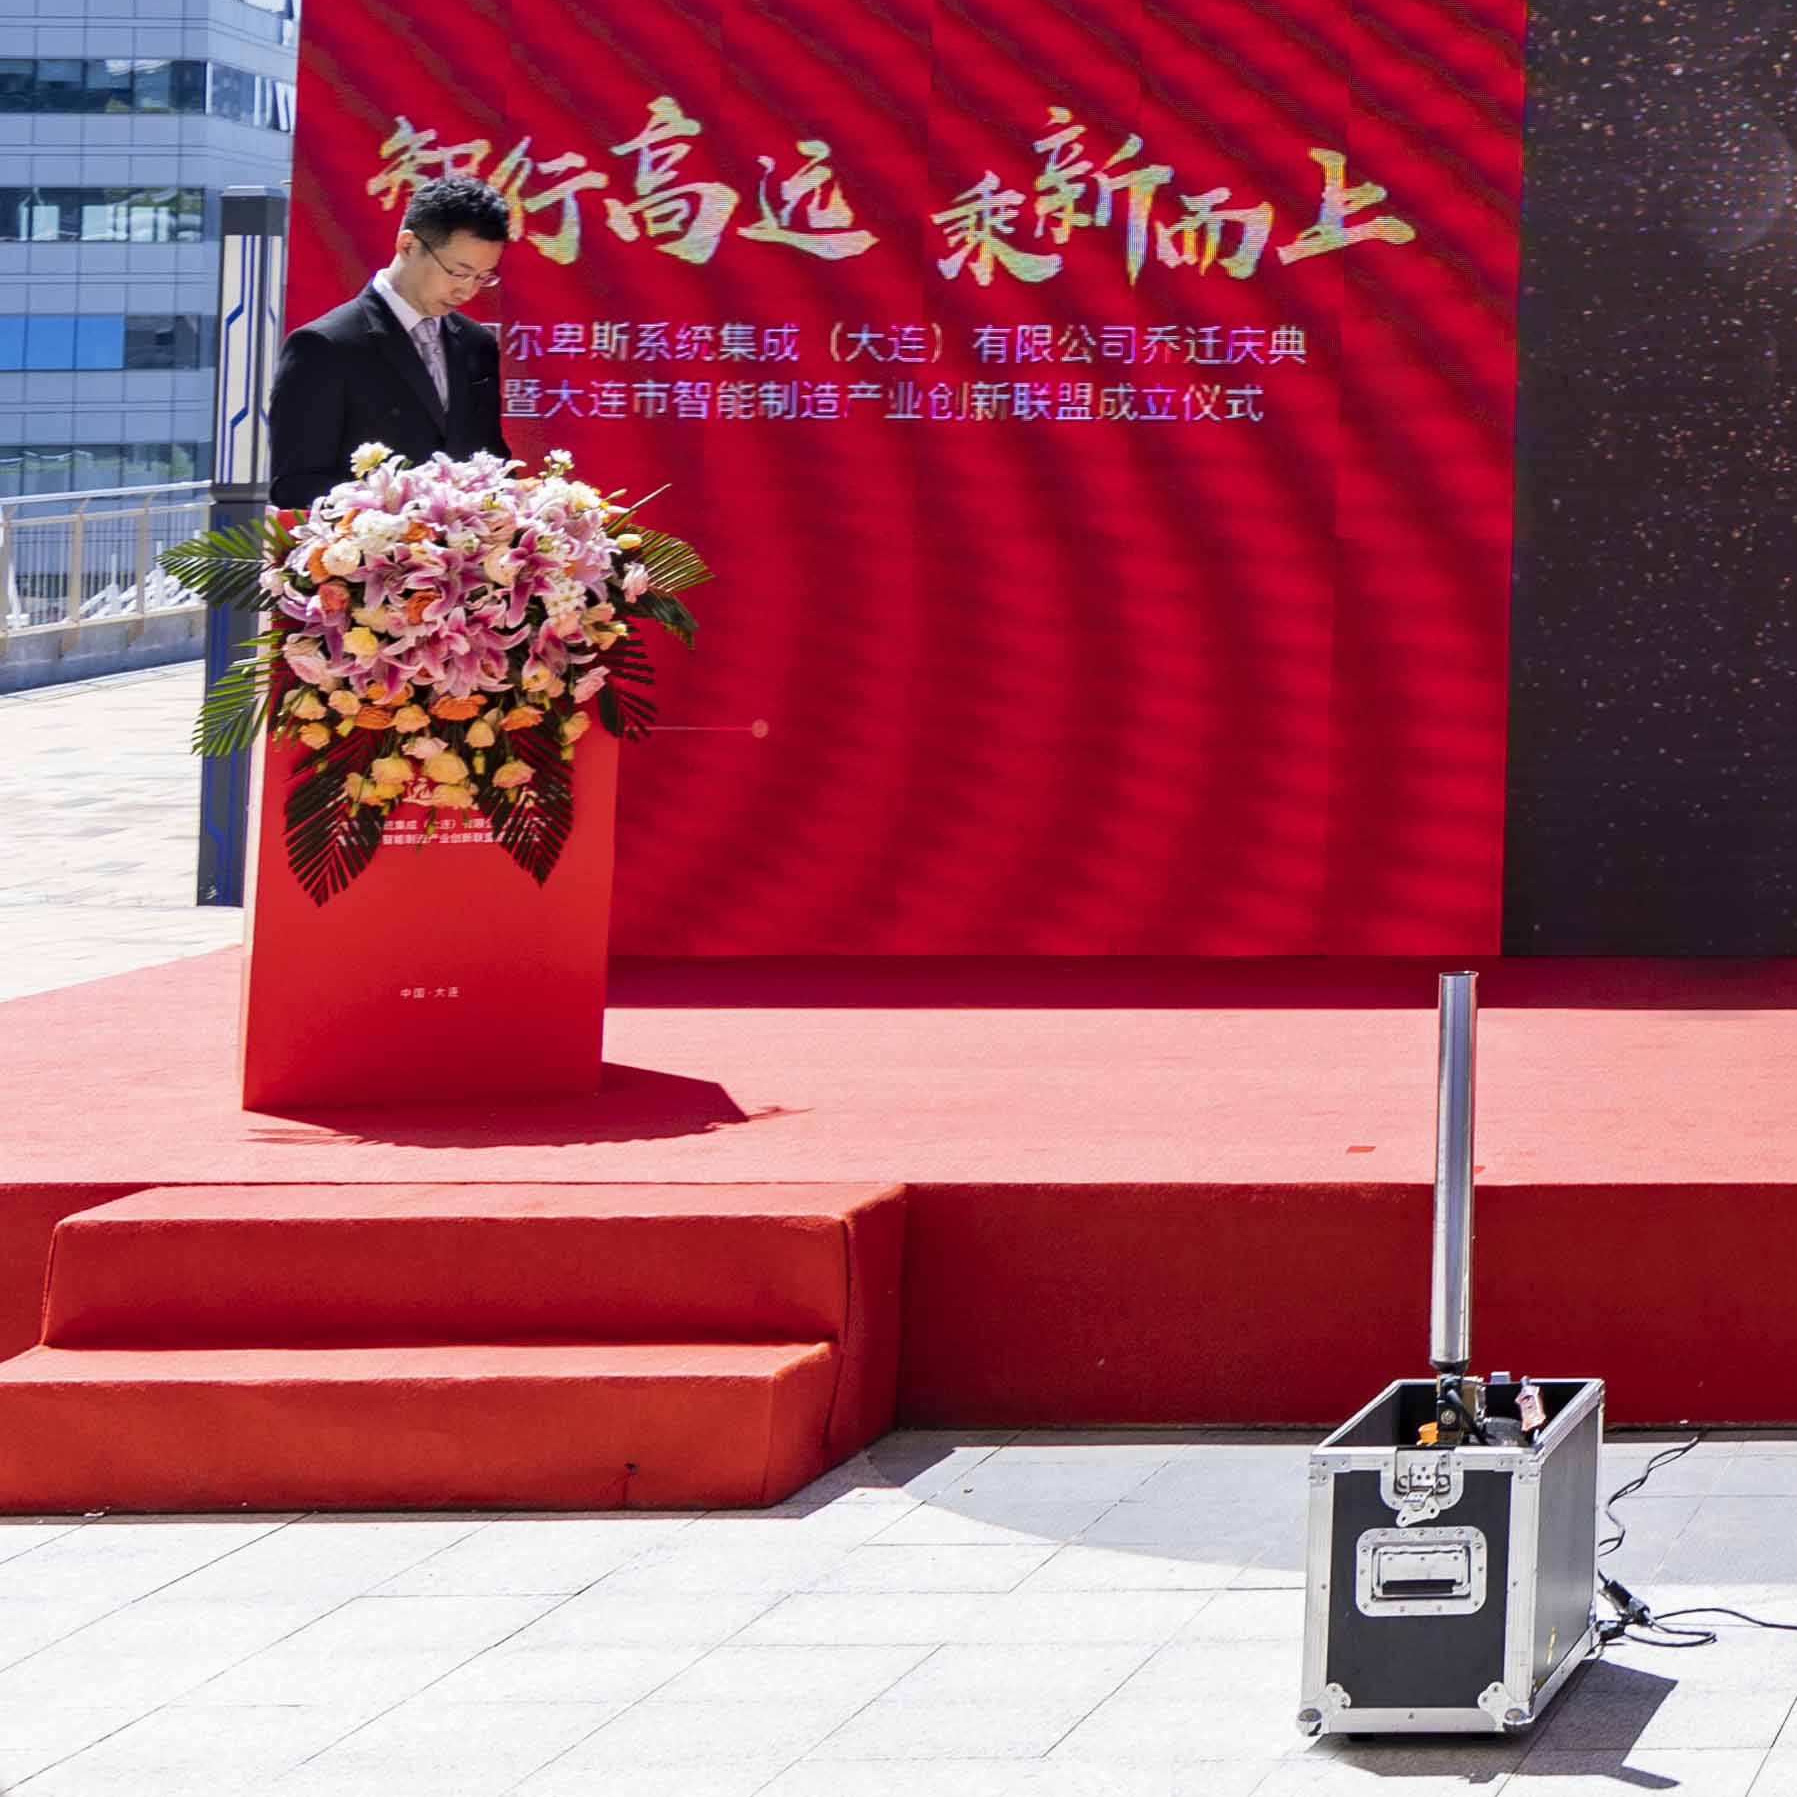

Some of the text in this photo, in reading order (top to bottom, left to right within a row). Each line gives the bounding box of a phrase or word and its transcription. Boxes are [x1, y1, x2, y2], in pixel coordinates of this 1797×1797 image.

[931, 106, 1416, 287] 乘新而上
[503, 378, 1264, 422] 暨大连市智能制造产业创新联盟成立仪式
